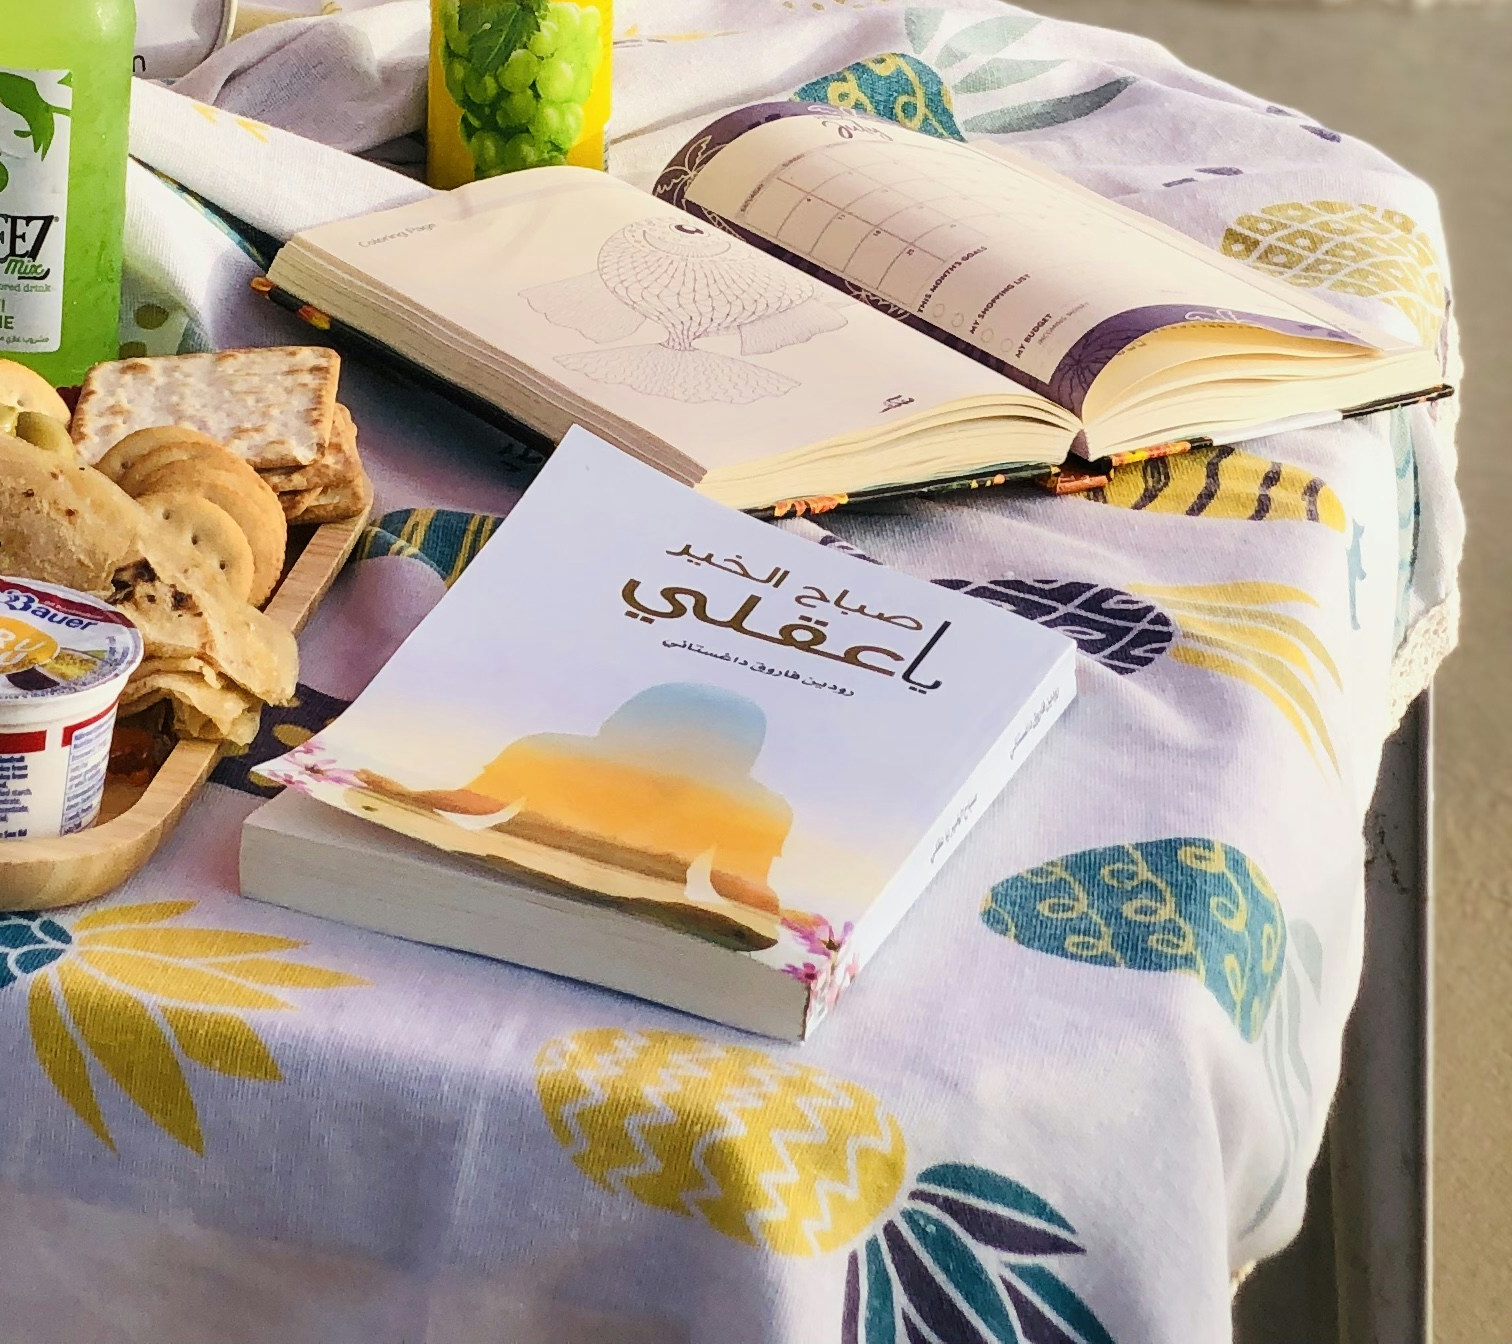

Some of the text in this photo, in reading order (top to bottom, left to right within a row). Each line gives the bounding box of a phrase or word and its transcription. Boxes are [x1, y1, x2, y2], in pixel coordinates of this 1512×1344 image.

[23, 282, 52, 293] drink
[917, 293, 932, 314] THIS
[961, 245, 988, 263] GOALS
[969, 273, 1032, 335] MY SHOPPING LIST
[1015, 312, 1053, 359] MY BUDGET
[665, 543, 923, 631] صباح الخير
[621, 577, 906, 679] عقلي
[661, 639, 855, 697] رودين فاروق داغستاني
